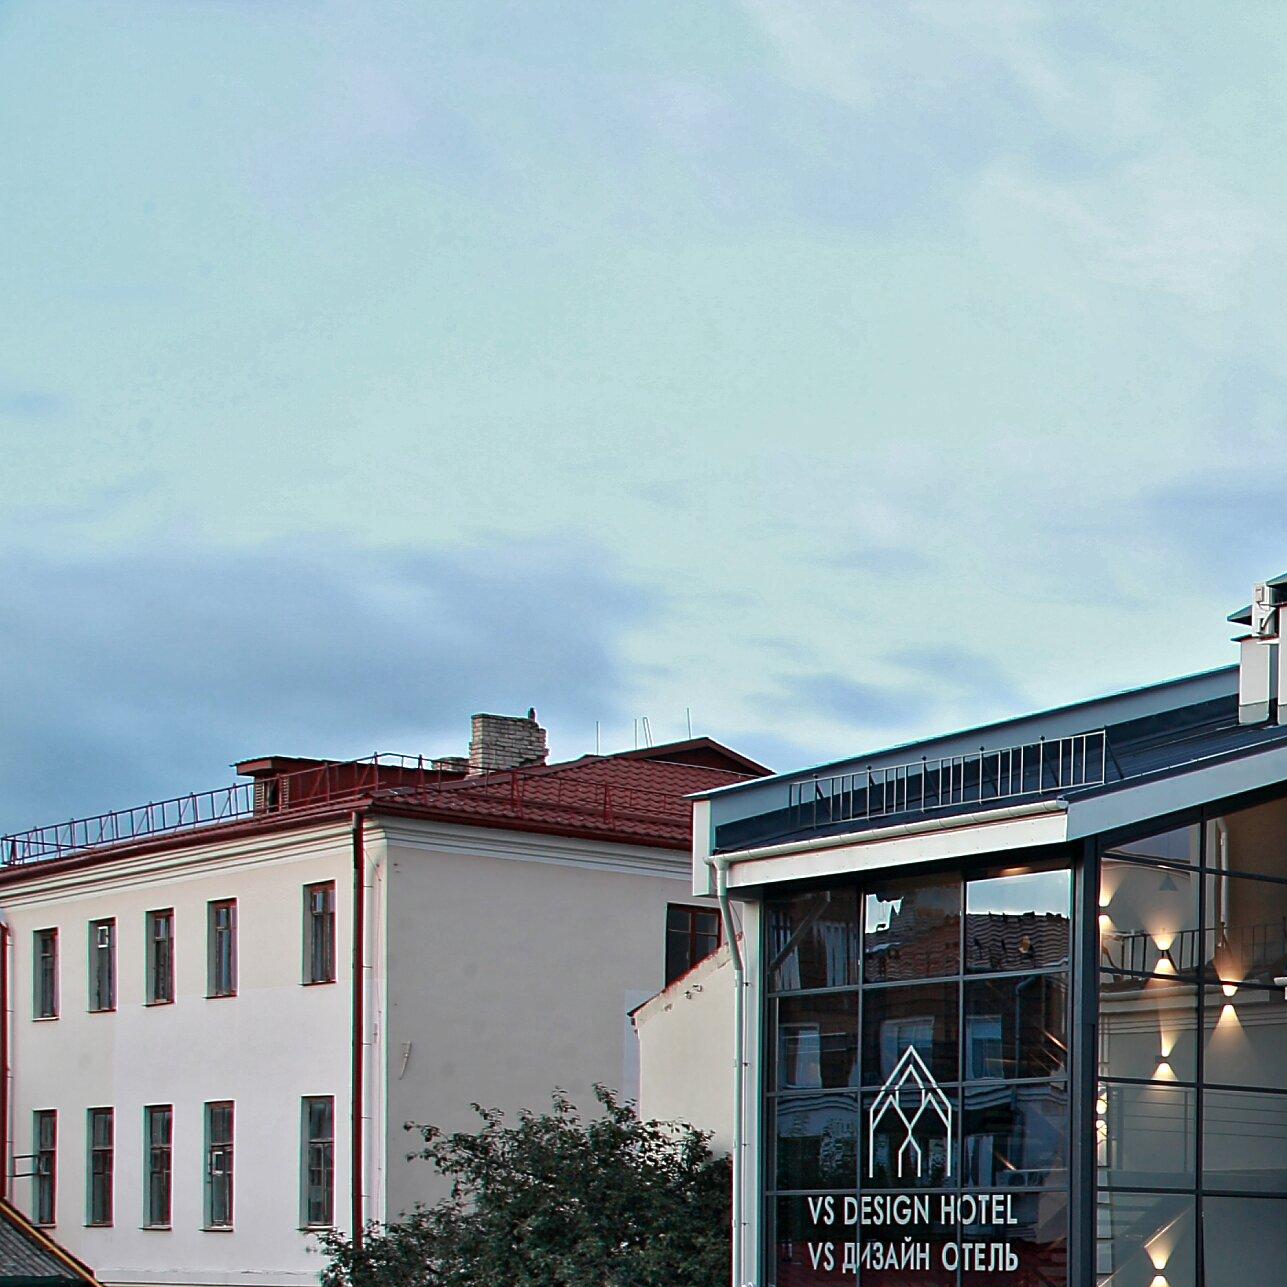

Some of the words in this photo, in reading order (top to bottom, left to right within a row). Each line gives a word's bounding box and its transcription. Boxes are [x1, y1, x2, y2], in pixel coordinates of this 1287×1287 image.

[807, 1196, 835, 1225] VS
[844, 1194, 929, 1225] DESIGN
[941, 1194, 1018, 1225] HOTEL
[807, 1242, 835, 1271] VS
[842, 1236, 930, 1274] ДИЗАЙН
[941, 1242, 1019, 1272] ОТЕЛЬ
